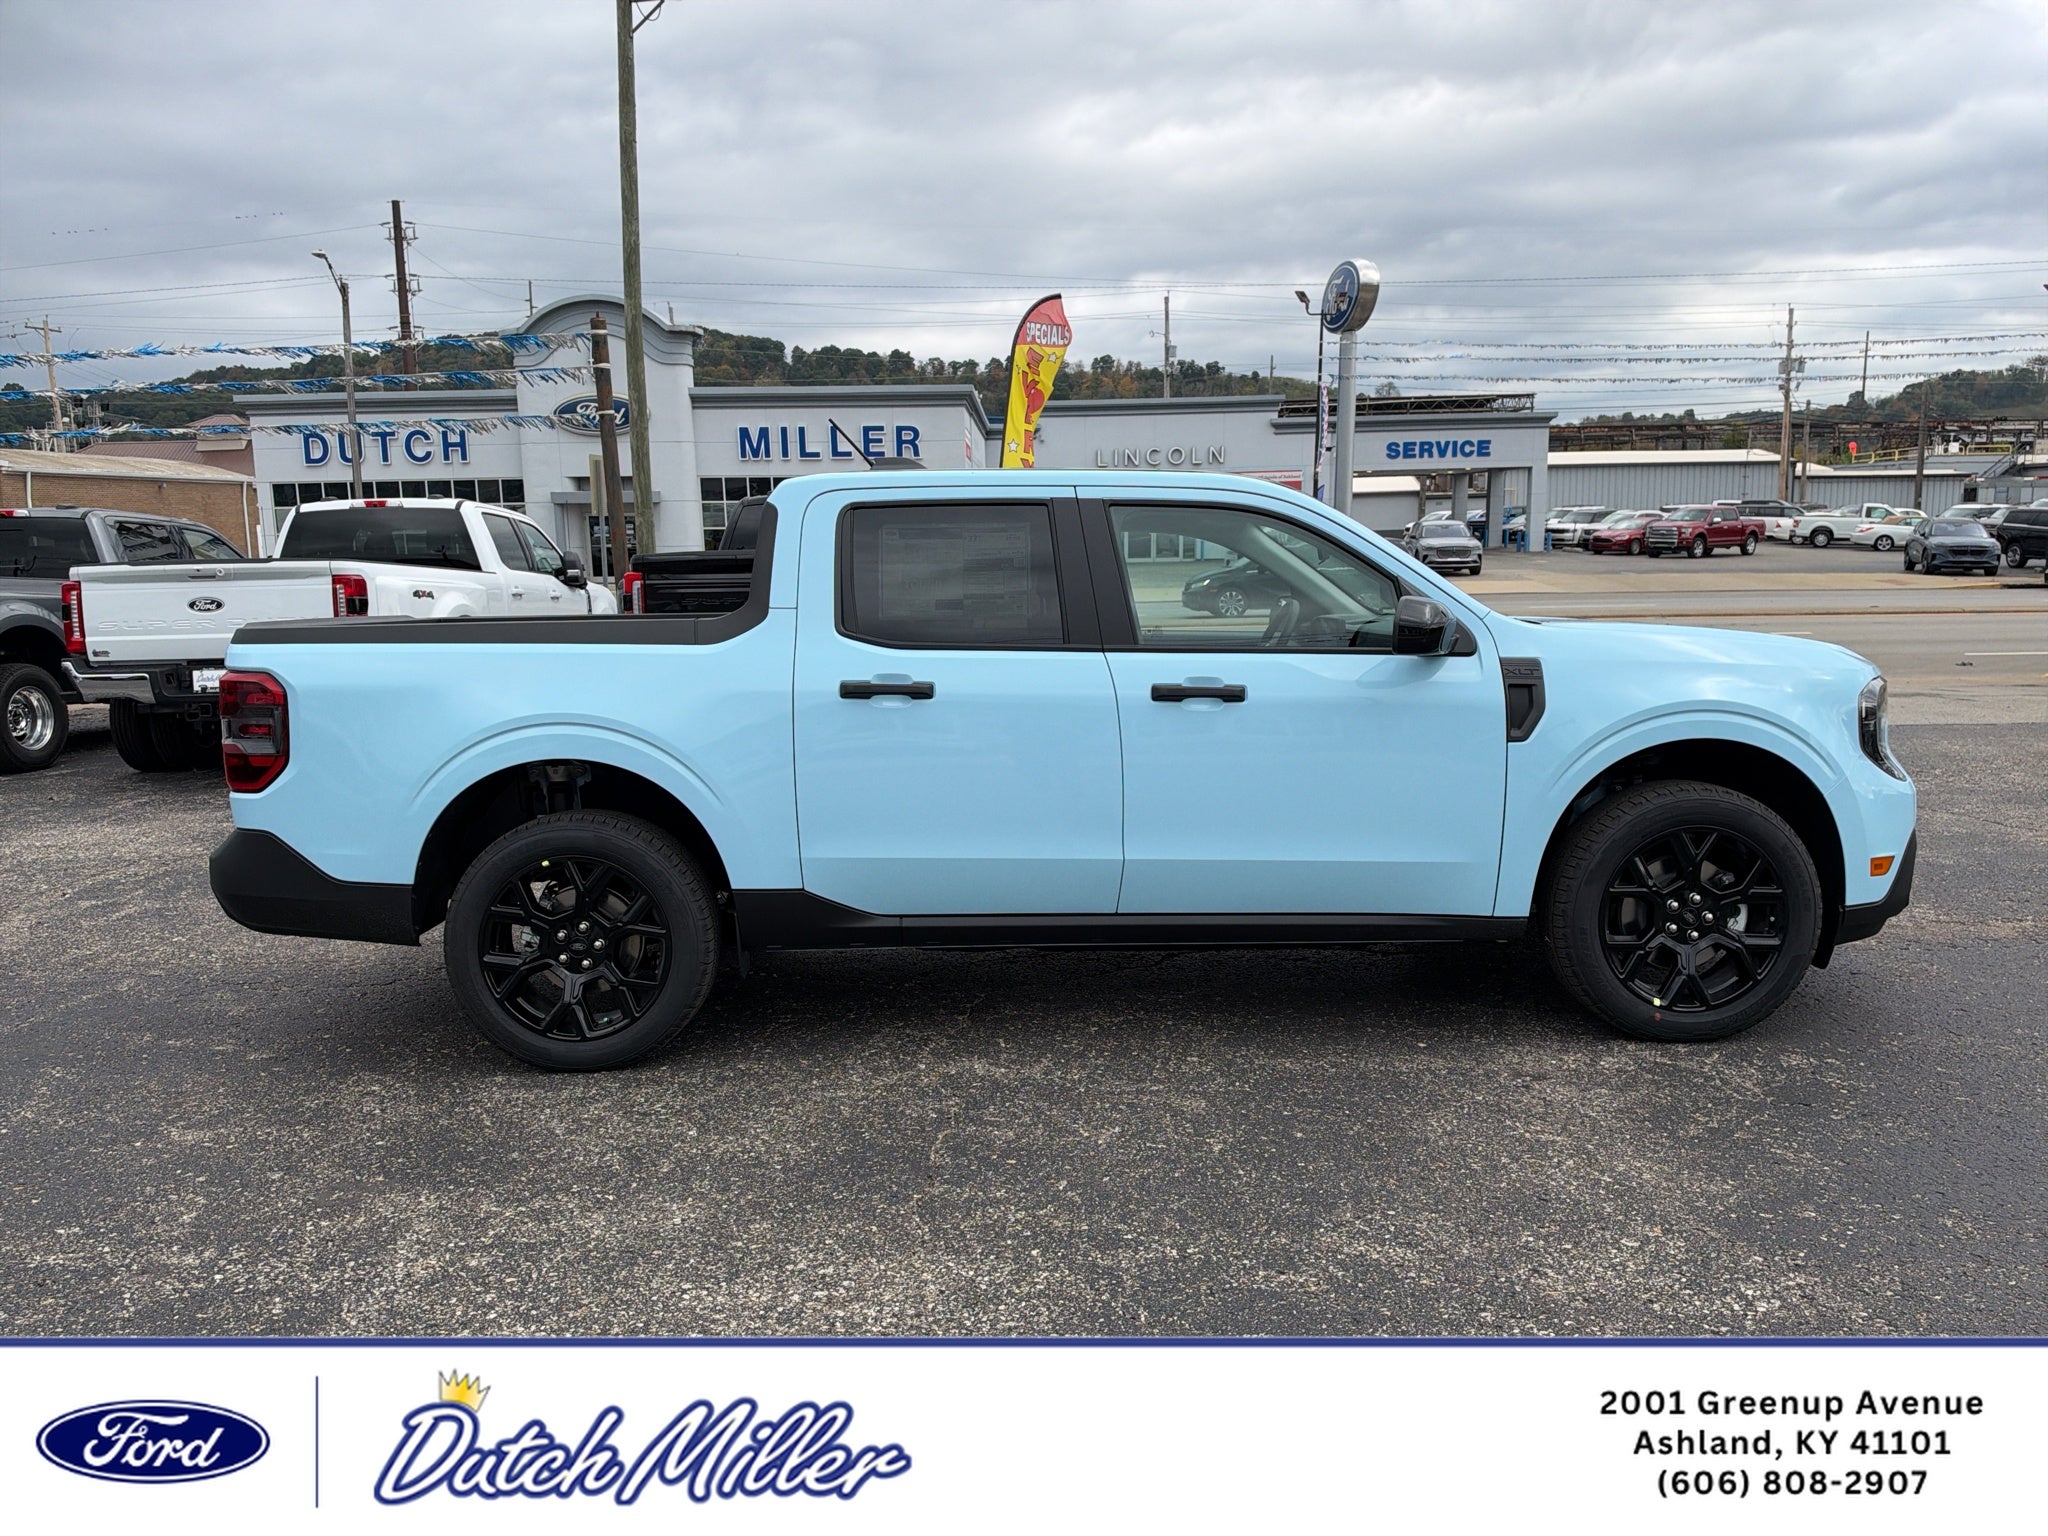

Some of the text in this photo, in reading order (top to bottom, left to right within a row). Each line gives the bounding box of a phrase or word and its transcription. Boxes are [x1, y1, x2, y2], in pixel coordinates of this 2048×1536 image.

[1026, 321, 1070, 346] SPECIALS
[302, 425, 922, 466] DUTCH MILLER
[1386, 440, 1492, 460] SERVICE
[1096, 446, 1225, 467] LINCOLN
[193, 598, 217, 611] Ford
[98, 618, 217, 631] SUPER
[1504, 667, 1540, 676] XLT
